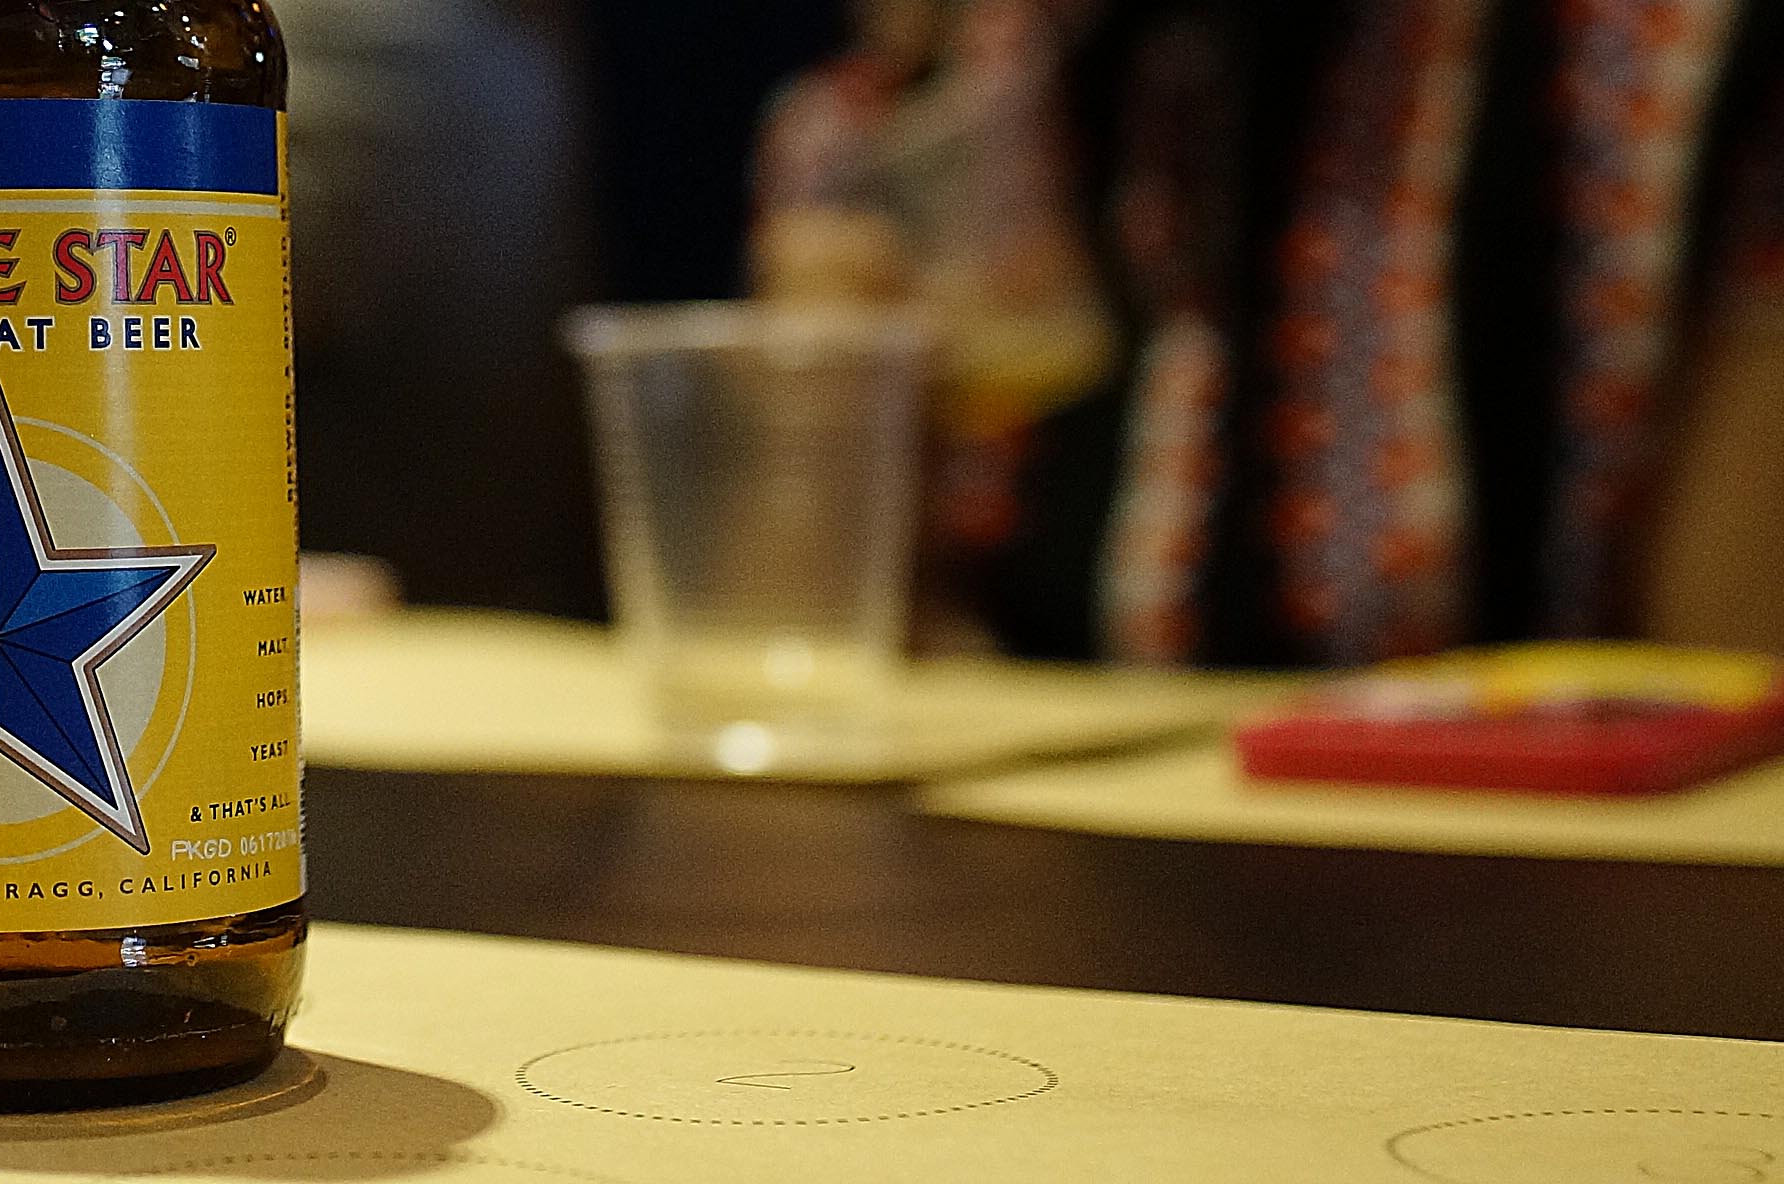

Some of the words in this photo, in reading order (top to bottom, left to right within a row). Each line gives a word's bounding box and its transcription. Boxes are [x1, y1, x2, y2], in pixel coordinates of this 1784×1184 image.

[89, 316, 202, 350] BEER
[190, 806, 202, 822] &
[209, 797, 267, 820] THAT'S
[171, 838, 232, 861] PKGD
[119, 861, 272, 894] CALIFORNIA
